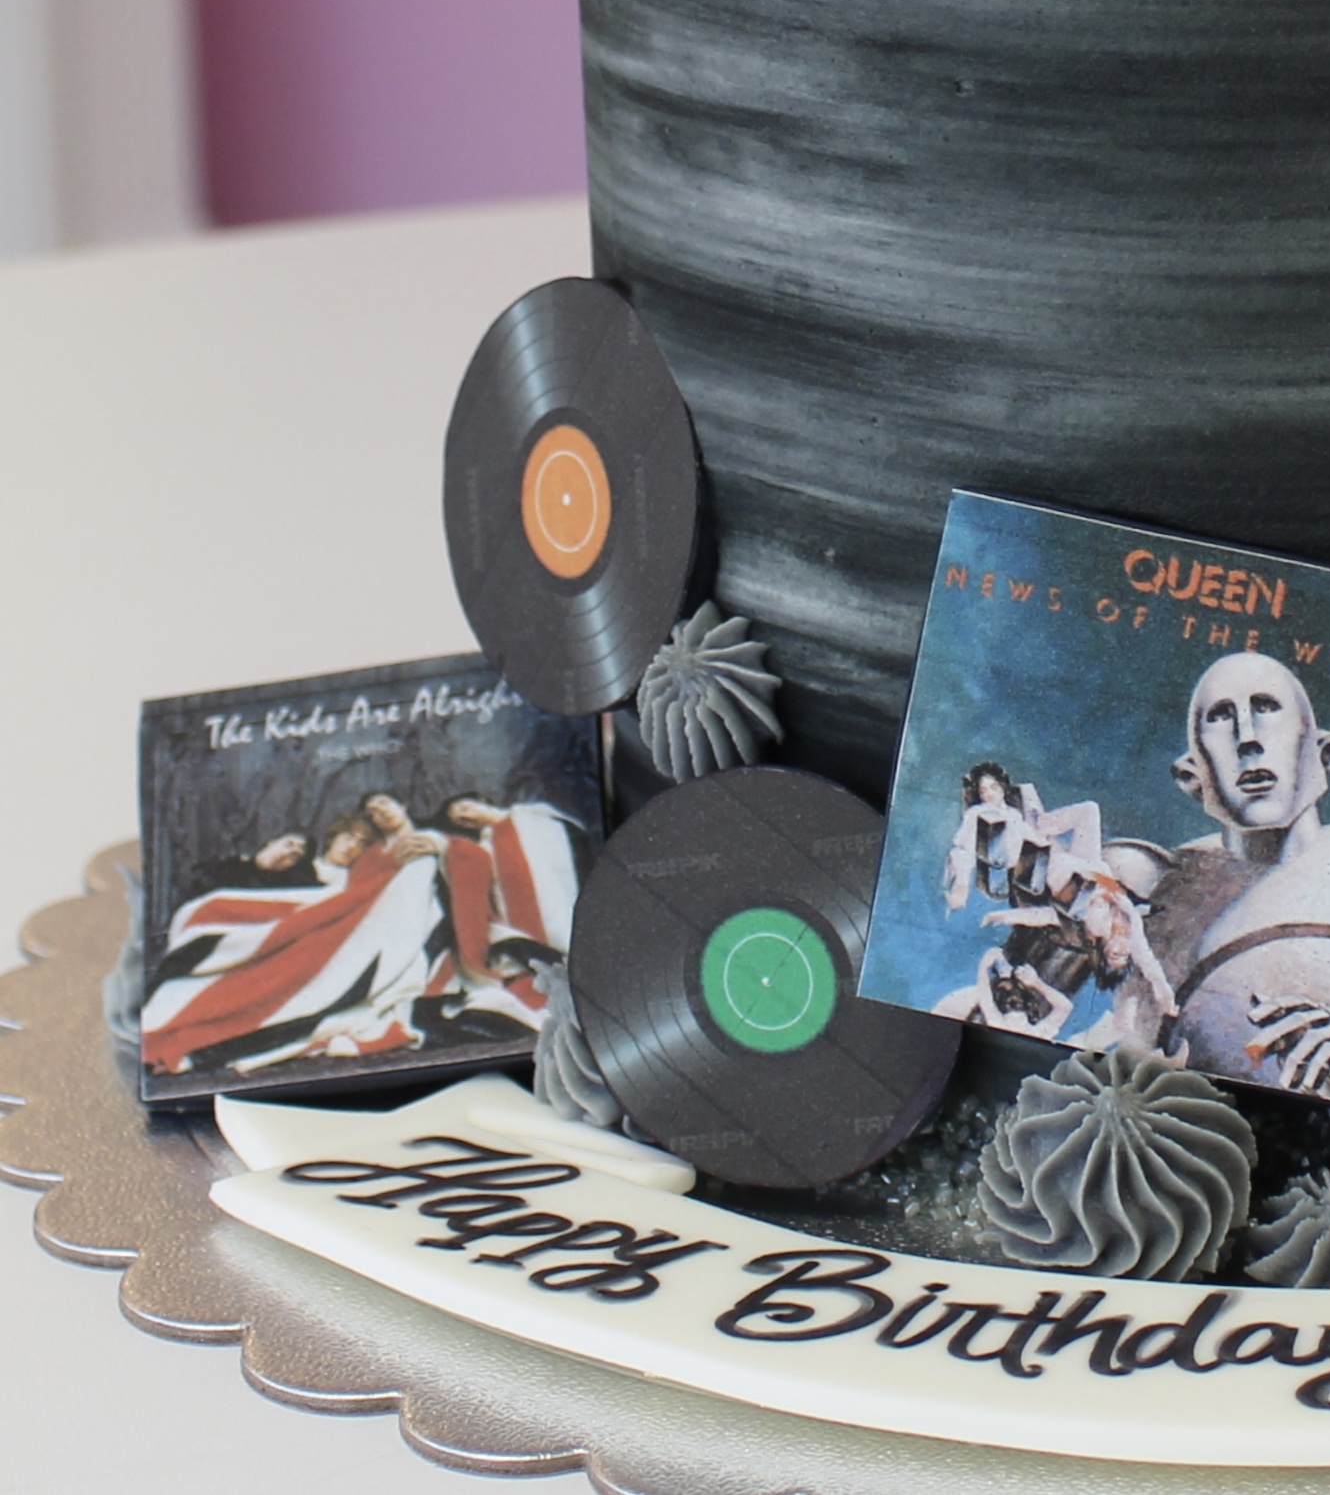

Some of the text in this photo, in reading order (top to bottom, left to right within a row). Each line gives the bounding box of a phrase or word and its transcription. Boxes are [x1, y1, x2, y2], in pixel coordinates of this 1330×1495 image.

[945, 565, 1063, 611] NEWS
[1096, 598, 1149, 629] OF
[1182, 615, 1260, 652] THE
[1123, 548, 1288, 620] QUEEN
[205, 675, 524, 749] The Kids Are Alrigh
[282, 1135, 729, 1302] Happy
